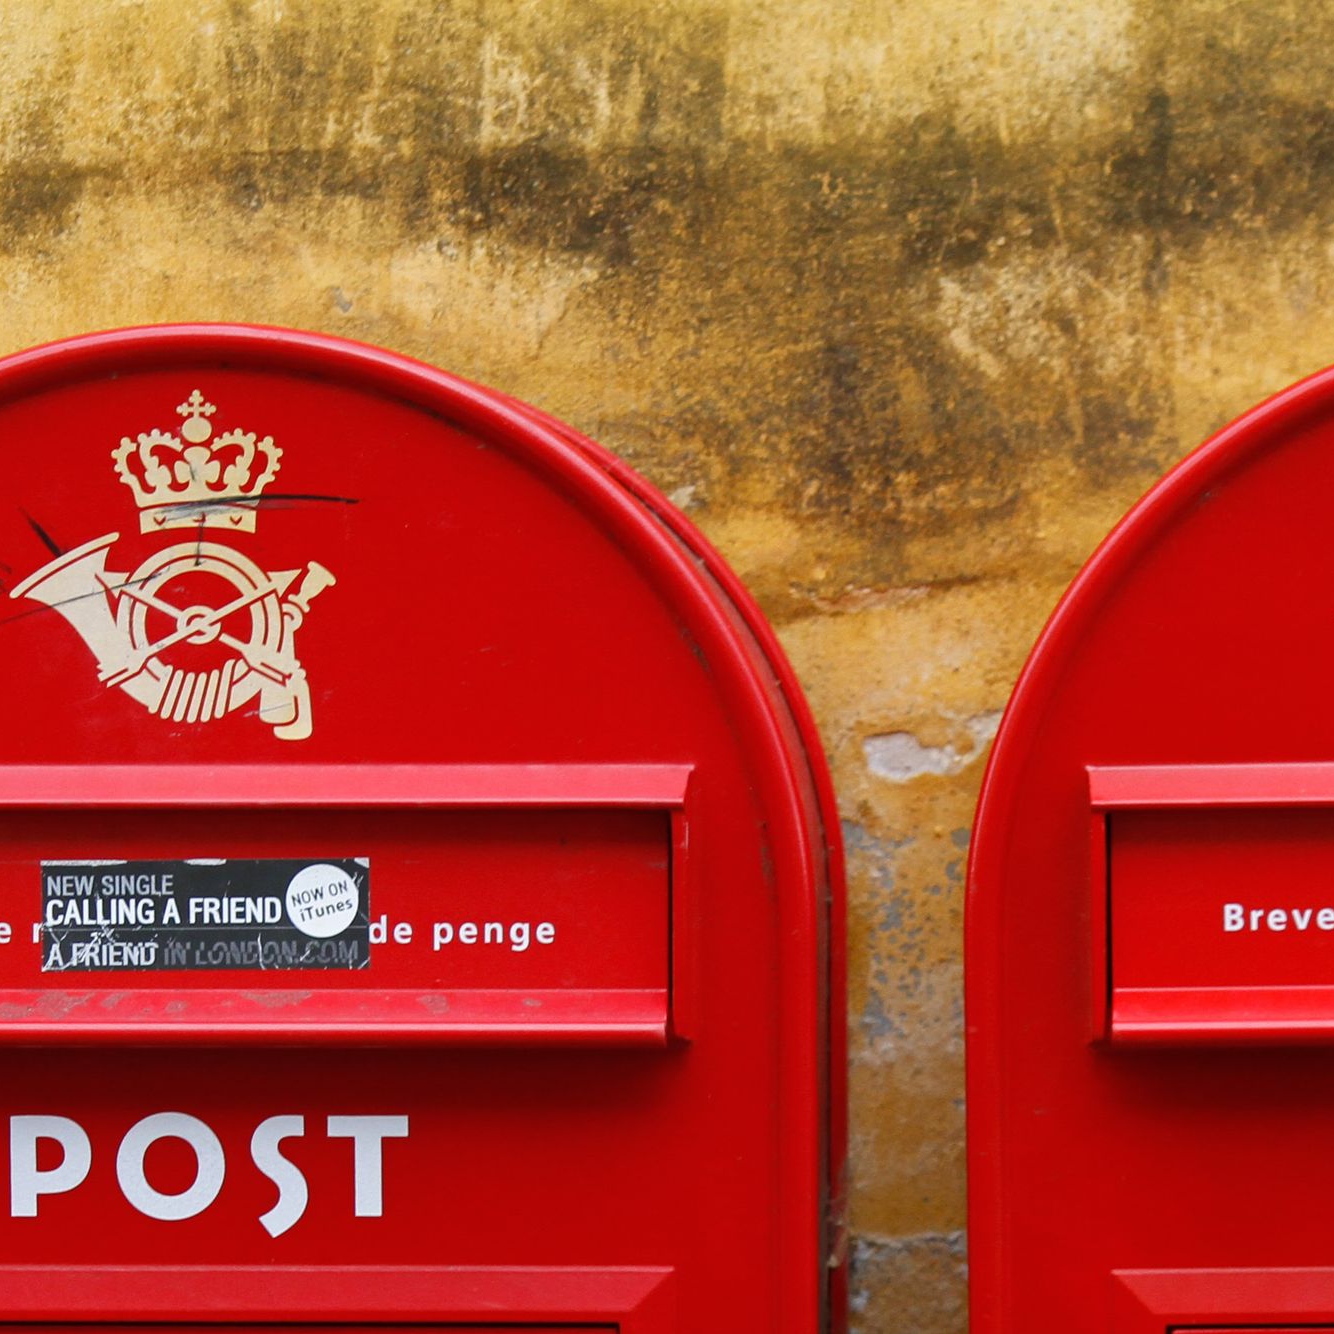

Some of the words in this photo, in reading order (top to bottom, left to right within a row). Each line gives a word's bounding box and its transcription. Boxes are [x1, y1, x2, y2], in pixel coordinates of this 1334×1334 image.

[47, 874, 93, 896] NEW
[101, 874, 174, 896] SINGLE
[291, 888, 325, 908] NOW
[328, 880, 348, 898] ON
[46, 898, 155, 925] CALLING
[163, 898, 181, 925] A
[189, 898, 281, 925] FRIEND
[300, 898, 353, 923] iTunes
[434, 922, 555, 951] penge
[51, 943, 64, 966] A
[72, 943, 157, 966] FRIEND
[164, 943, 188, 966] IN
[10, 1112, 408, 1238] POST
